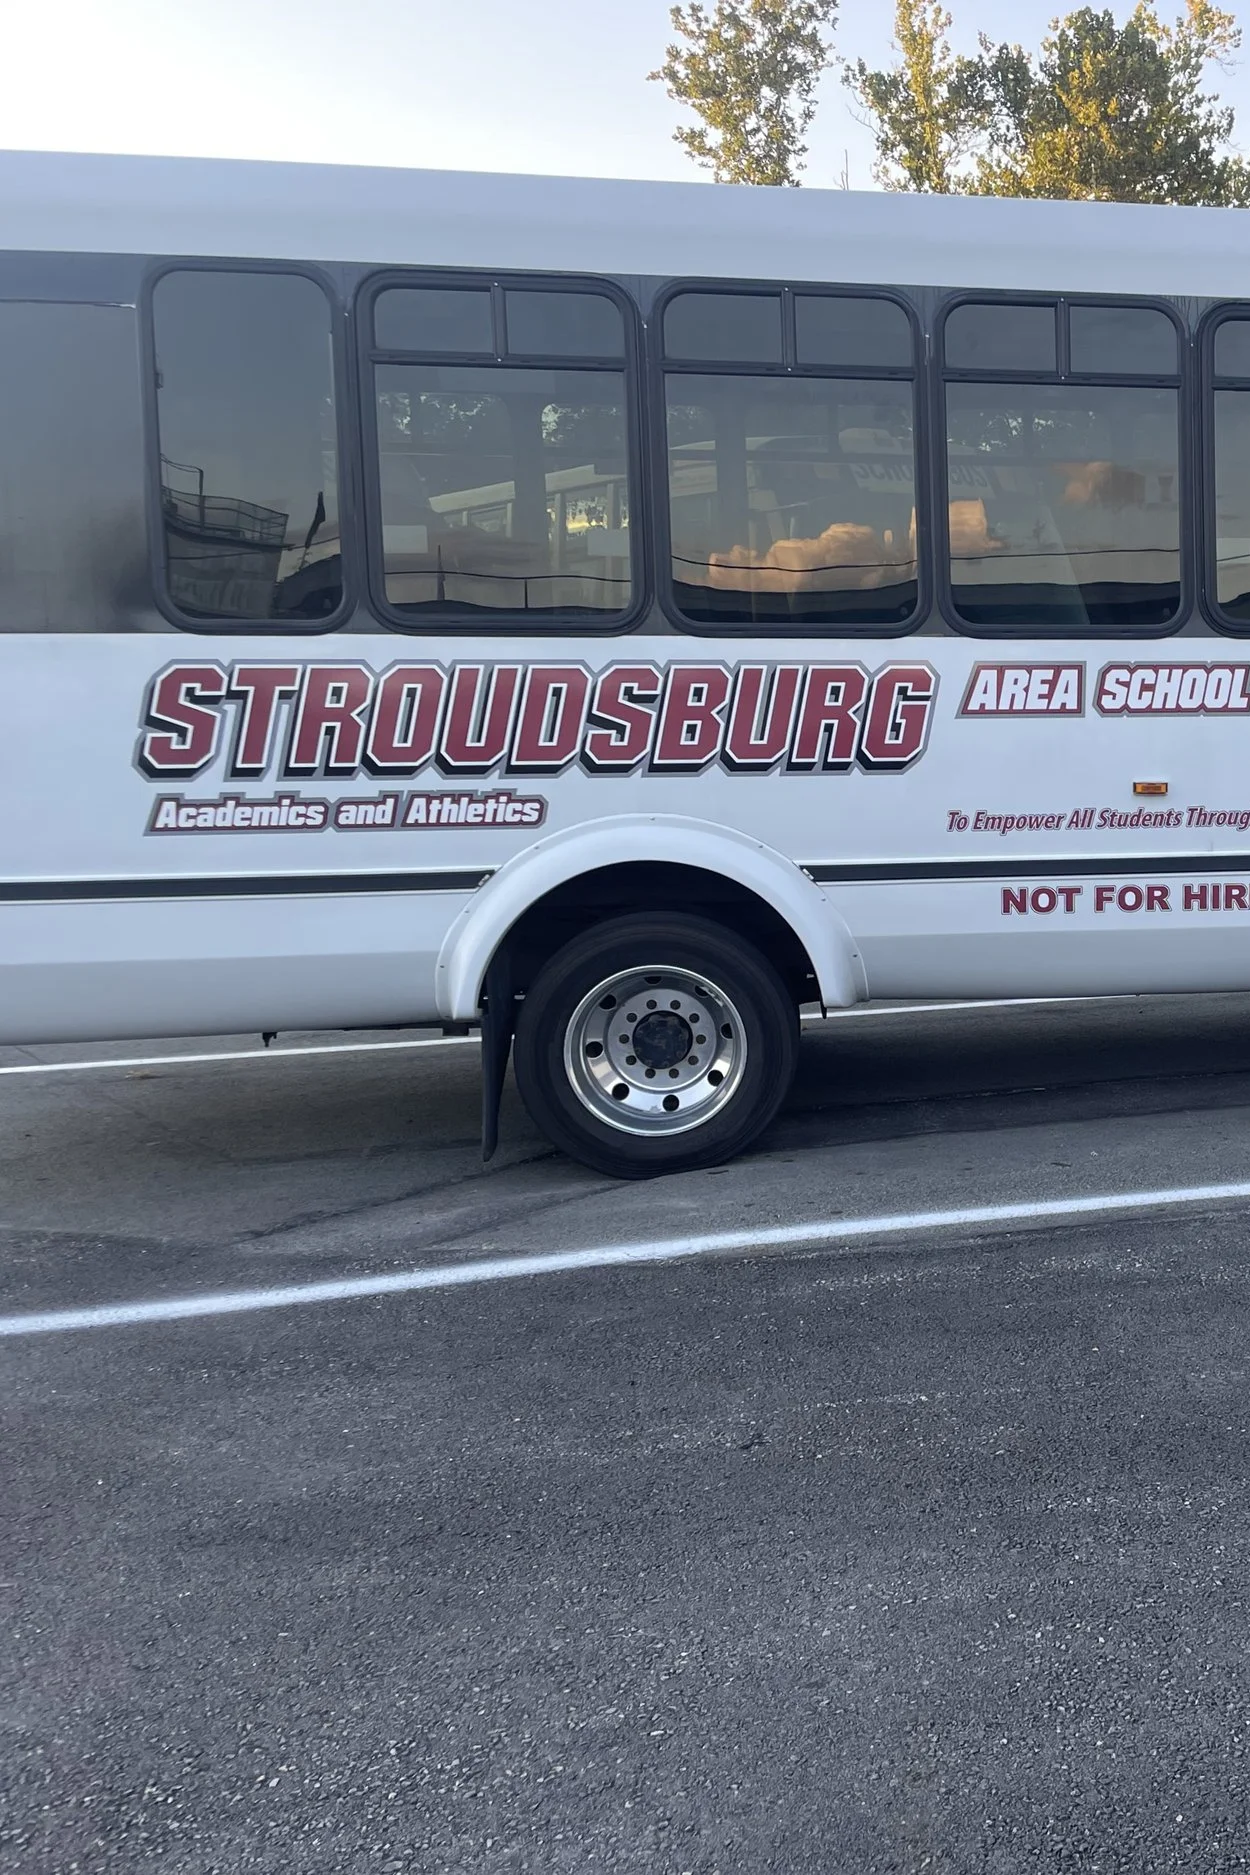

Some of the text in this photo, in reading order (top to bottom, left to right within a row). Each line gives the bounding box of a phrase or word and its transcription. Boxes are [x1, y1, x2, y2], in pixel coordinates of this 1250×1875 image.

[966, 667, 1080, 711] AREA
[138, 661, 938, 776] STROUDSBURG
[154, 795, 542, 829] Academics and Athletics
[948, 810, 970, 831] To
[972, 810, 1067, 836] Empower
[1067, 808, 1096, 830] All
[1097, 807, 1182, 829] Students
[1001, 886, 1083, 915] NOT
[1094, 884, 1172, 913] FOR
